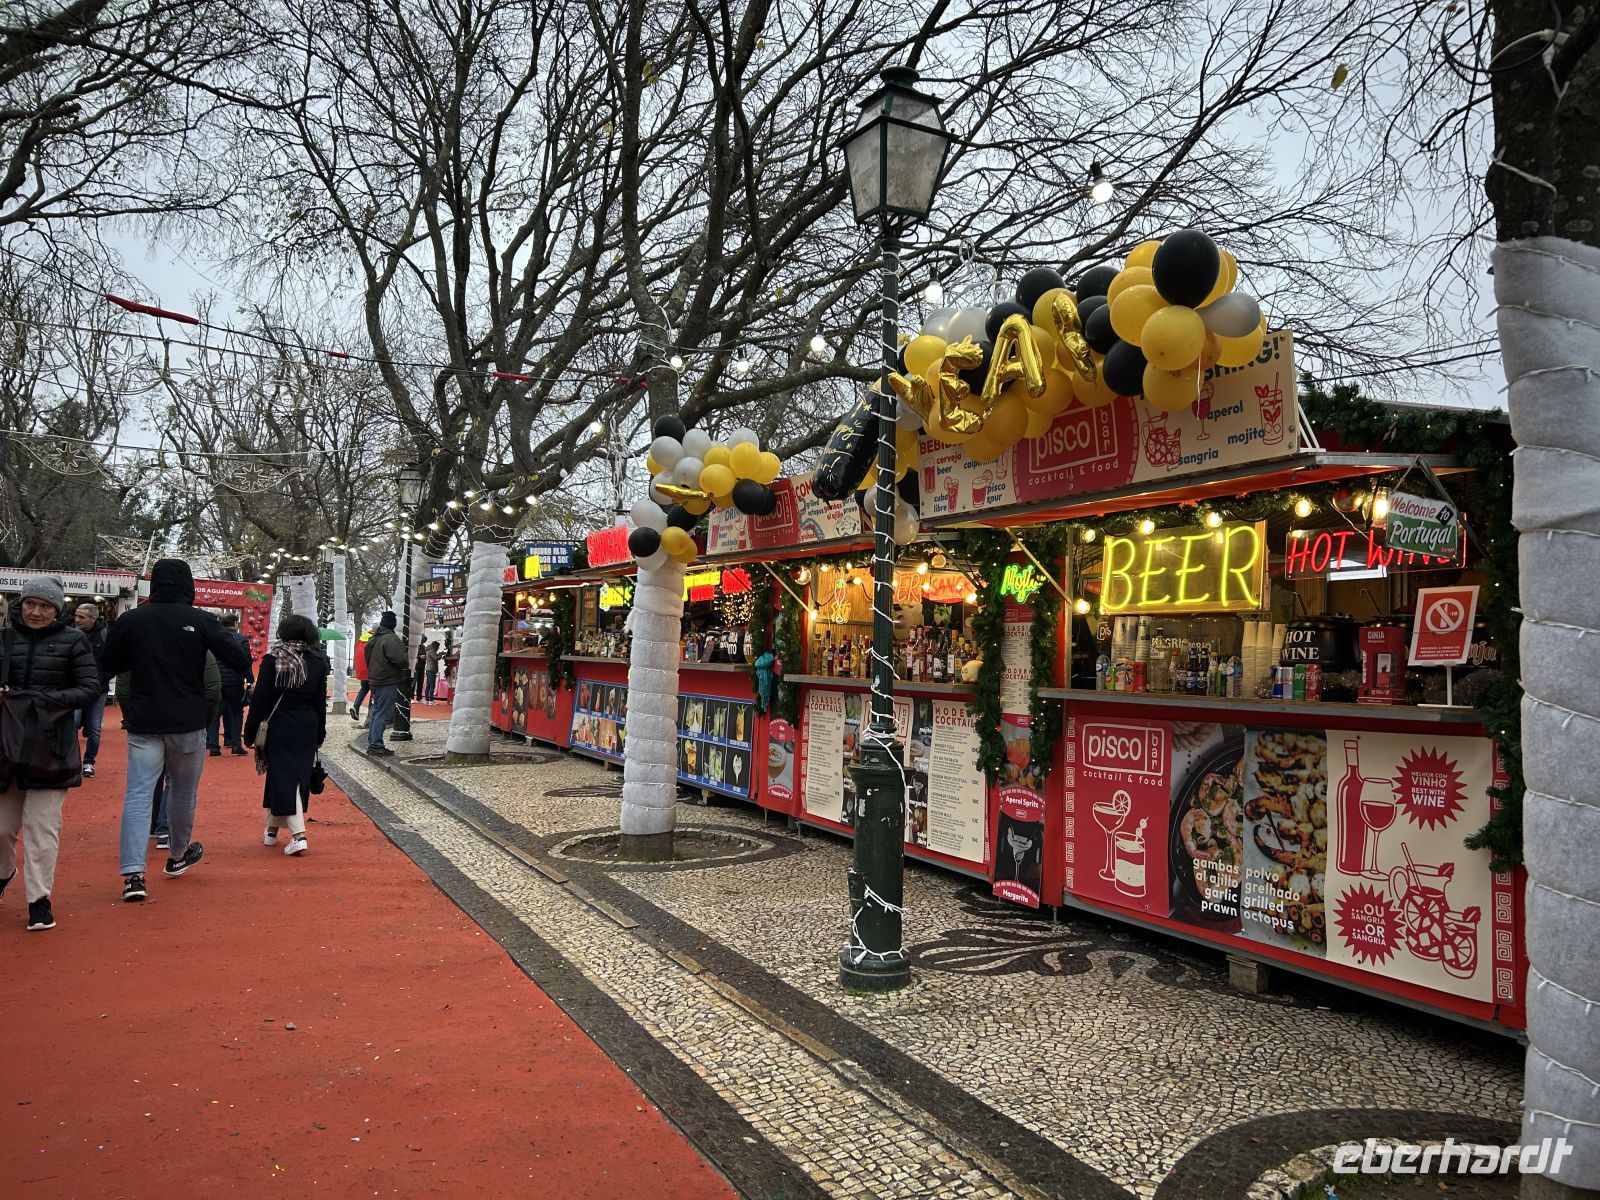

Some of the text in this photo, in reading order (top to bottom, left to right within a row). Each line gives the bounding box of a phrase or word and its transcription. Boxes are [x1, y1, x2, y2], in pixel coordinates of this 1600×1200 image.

[1206, 400, 1244, 422] aperol
[1100, 409, 1110, 452] bar
[1227, 428, 1266, 445] mojito
[936, 451, 962, 464] cerveja
[1178, 448, 1219, 465] sangria
[937, 465, 953, 475] beer
[1028, 458, 1119, 486] cocktail & food
[987, 482, 1006, 495] pisco
[987, 494, 1003, 504] sour
[934, 504, 947, 512] libre
[1390, 497, 1451, 521] Welcome to
[1390, 520, 1453, 550] Portugal
[1288, 531, 1355, 574] HOT
[1101, 525, 1260, 610] BEER
[68, 582, 88, 590] WINES
[206, 588, 243, 596] AGUARDAM
[1285, 630, 1316, 644] HOT
[1282, 647, 1320, 660] WINE
[810, 703, 842, 713] COCKTAILS
[811, 695, 842, 705] CLASSIC
[935, 715, 977, 728] COCKTAIL
[1088, 729, 1142, 762] pisco
[1083, 770, 1163, 787] cocktail & food
[1411, 776, 1447, 788] VINHO
[1006, 796, 1039, 808] Aperol Spritz
[1411, 793, 1445, 808] WINE
[1193, 858, 1239, 875] gambas
[1195, 870, 1239, 888] al ajillo
[1245, 867, 1280, 883] polvo
[1003, 889, 1029, 903] Margarita
[1204, 887, 1238, 903] garlic
[1244, 882, 1301, 901] grelhado
[1201, 900, 1238, 917] prawn
[1243, 896, 1284, 914] grilled
[1243, 910, 1294, 930] octopus
[1351, 912, 1386, 926] SANGRIA
[1352, 932, 1387, 946] SANGRIA
